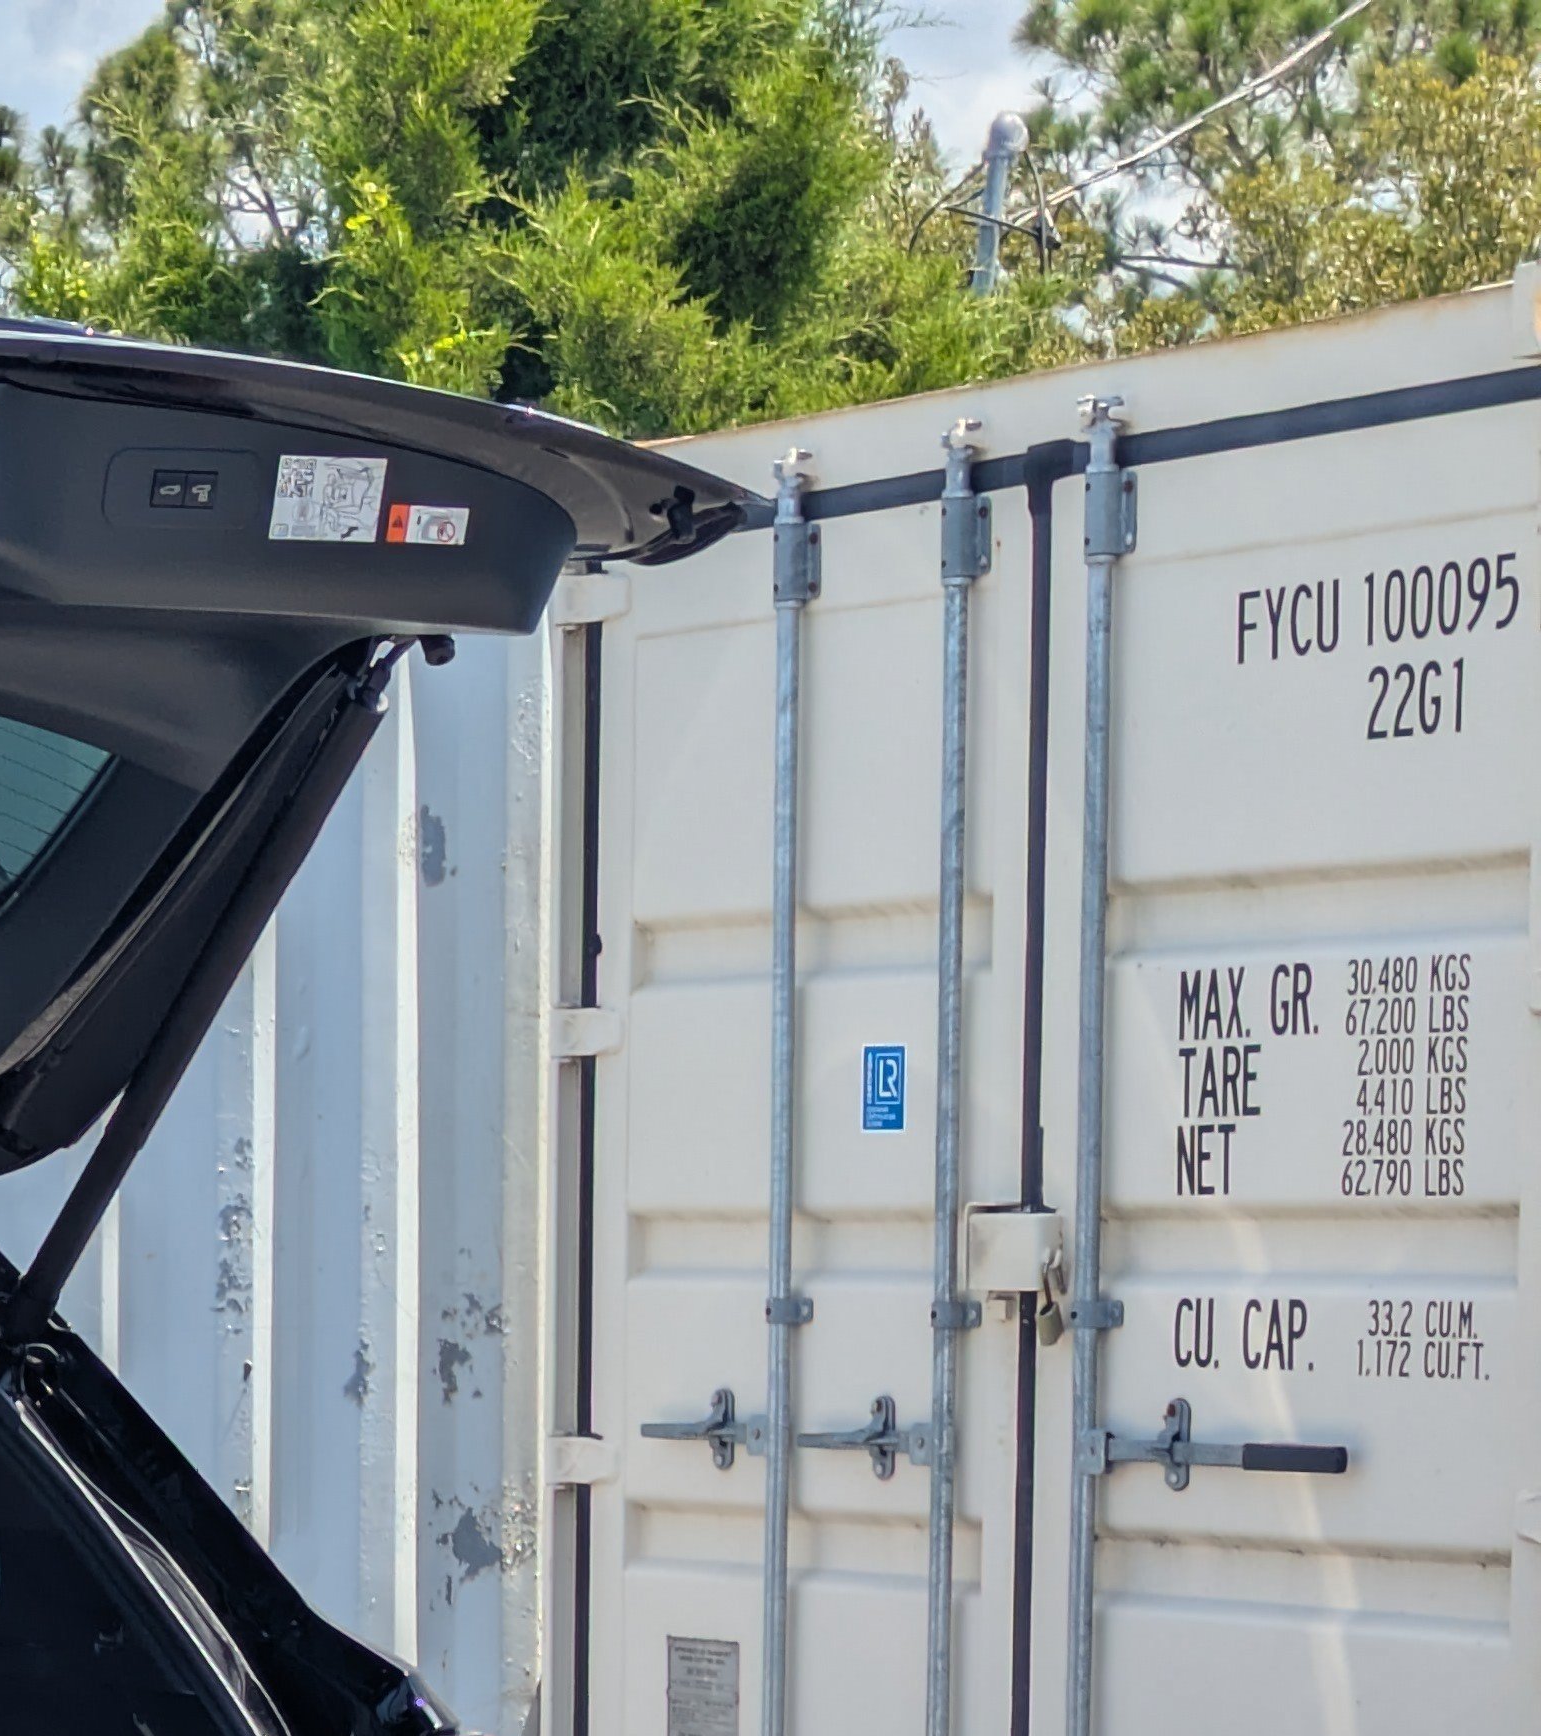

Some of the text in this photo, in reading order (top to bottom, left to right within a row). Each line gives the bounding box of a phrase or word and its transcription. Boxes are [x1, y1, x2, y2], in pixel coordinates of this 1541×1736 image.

[1237, 552, 1520, 664] FYCU 100095
[1366, 657, 1465, 740] 22G1
[1430, 954, 1471, 993] KGS
[1179, 962, 1319, 1041] MAX. GR.
[1428, 995, 1469, 1033] LBS
[1427, 1036, 1468, 1074] KGS
[1178, 1044, 1262, 1118] TARE
[1426, 1076, 1467, 1115] LBS
[1425, 1117, 1465, 1156] KGS
[1177, 1123, 1236, 1196] NET
[1424, 1158, 1464, 1197] LBS
[1174, 1298, 1314, 1371] CU. CAP.
[1368, 1299, 1478, 1339] 33.2 CU.M.
[1423, 1340, 1490, 1380] CU.FT.
